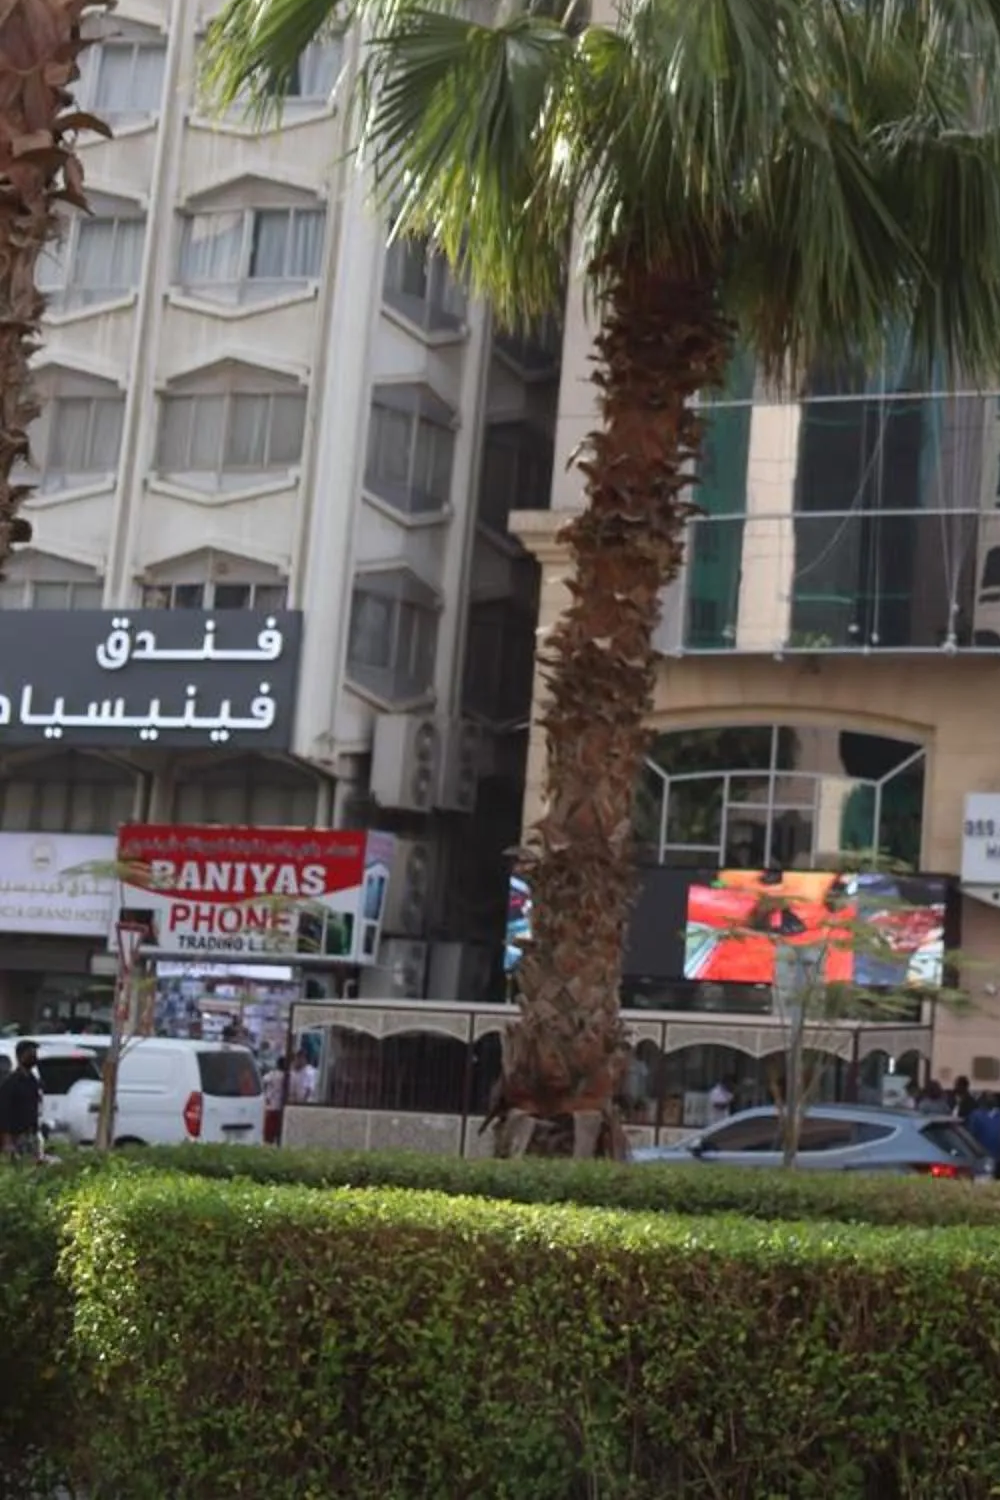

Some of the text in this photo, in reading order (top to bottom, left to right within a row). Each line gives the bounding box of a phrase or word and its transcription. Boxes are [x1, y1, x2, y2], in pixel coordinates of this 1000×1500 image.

[95, 615, 284, 670] فندق
[151, 859, 328, 897] BANIYAS
[168, 903, 291, 936] PHONE
